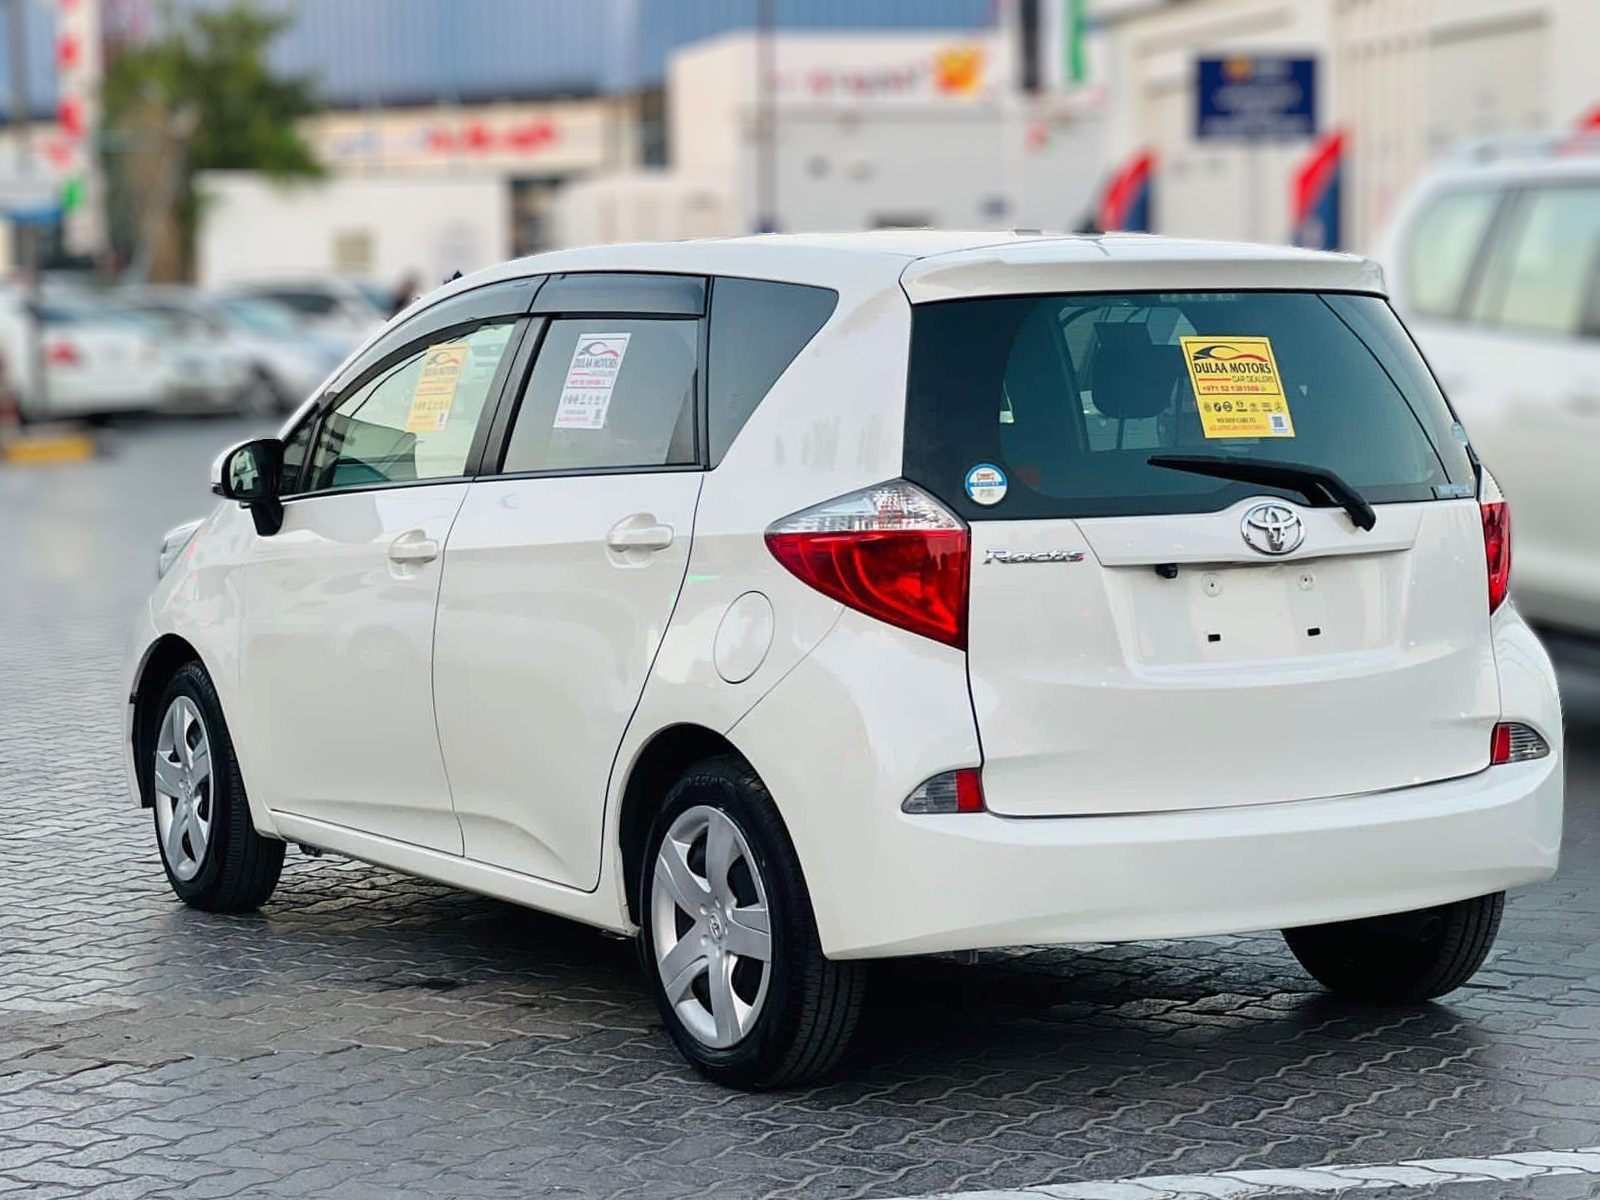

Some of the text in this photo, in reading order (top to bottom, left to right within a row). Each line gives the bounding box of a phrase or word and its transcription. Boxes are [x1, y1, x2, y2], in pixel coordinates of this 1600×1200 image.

[1194, 362, 1272, 374] DULAA MOTORS
[1231, 375, 1276, 383] CAR DEALERS
[983, 549, 1084, 565] Ractis
